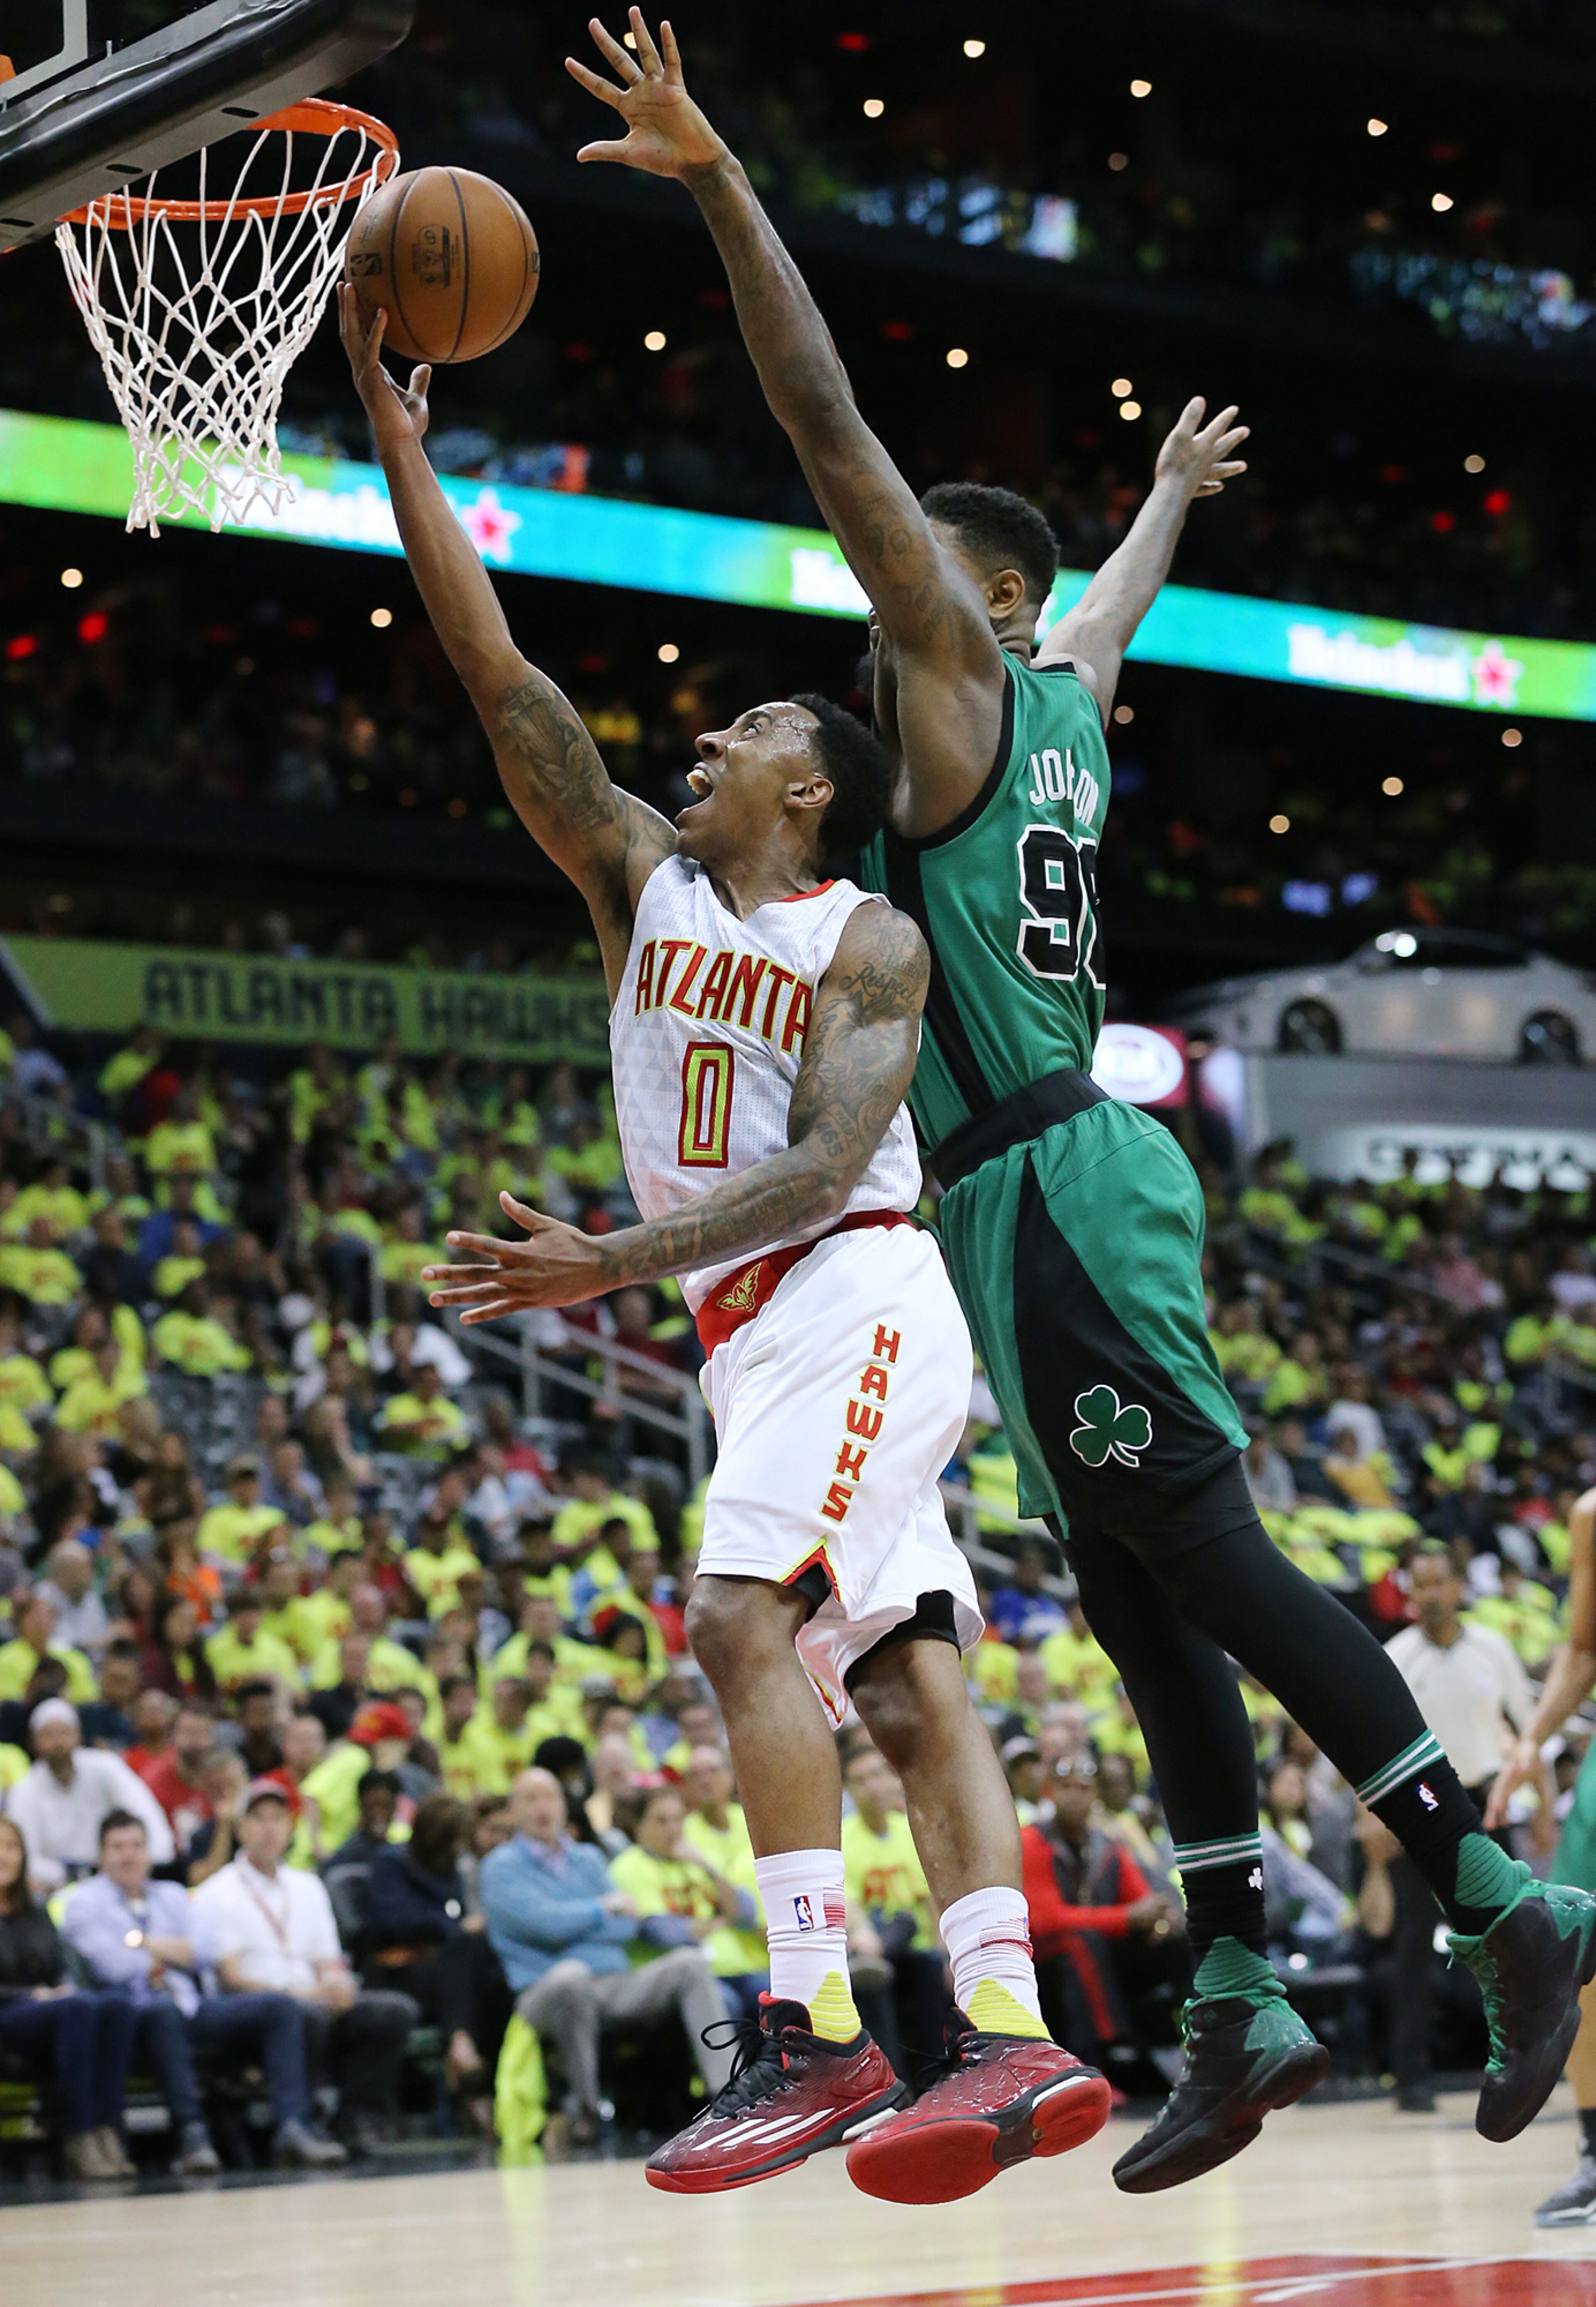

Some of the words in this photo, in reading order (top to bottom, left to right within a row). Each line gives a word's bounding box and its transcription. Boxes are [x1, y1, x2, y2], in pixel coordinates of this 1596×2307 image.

[143, 962, 398, 1031] ATLANTA
[634, 937, 813, 1058] ATLANTA
[678, 1041, 734, 1169] 0
[820, 1323, 901, 1522] HAWKS
